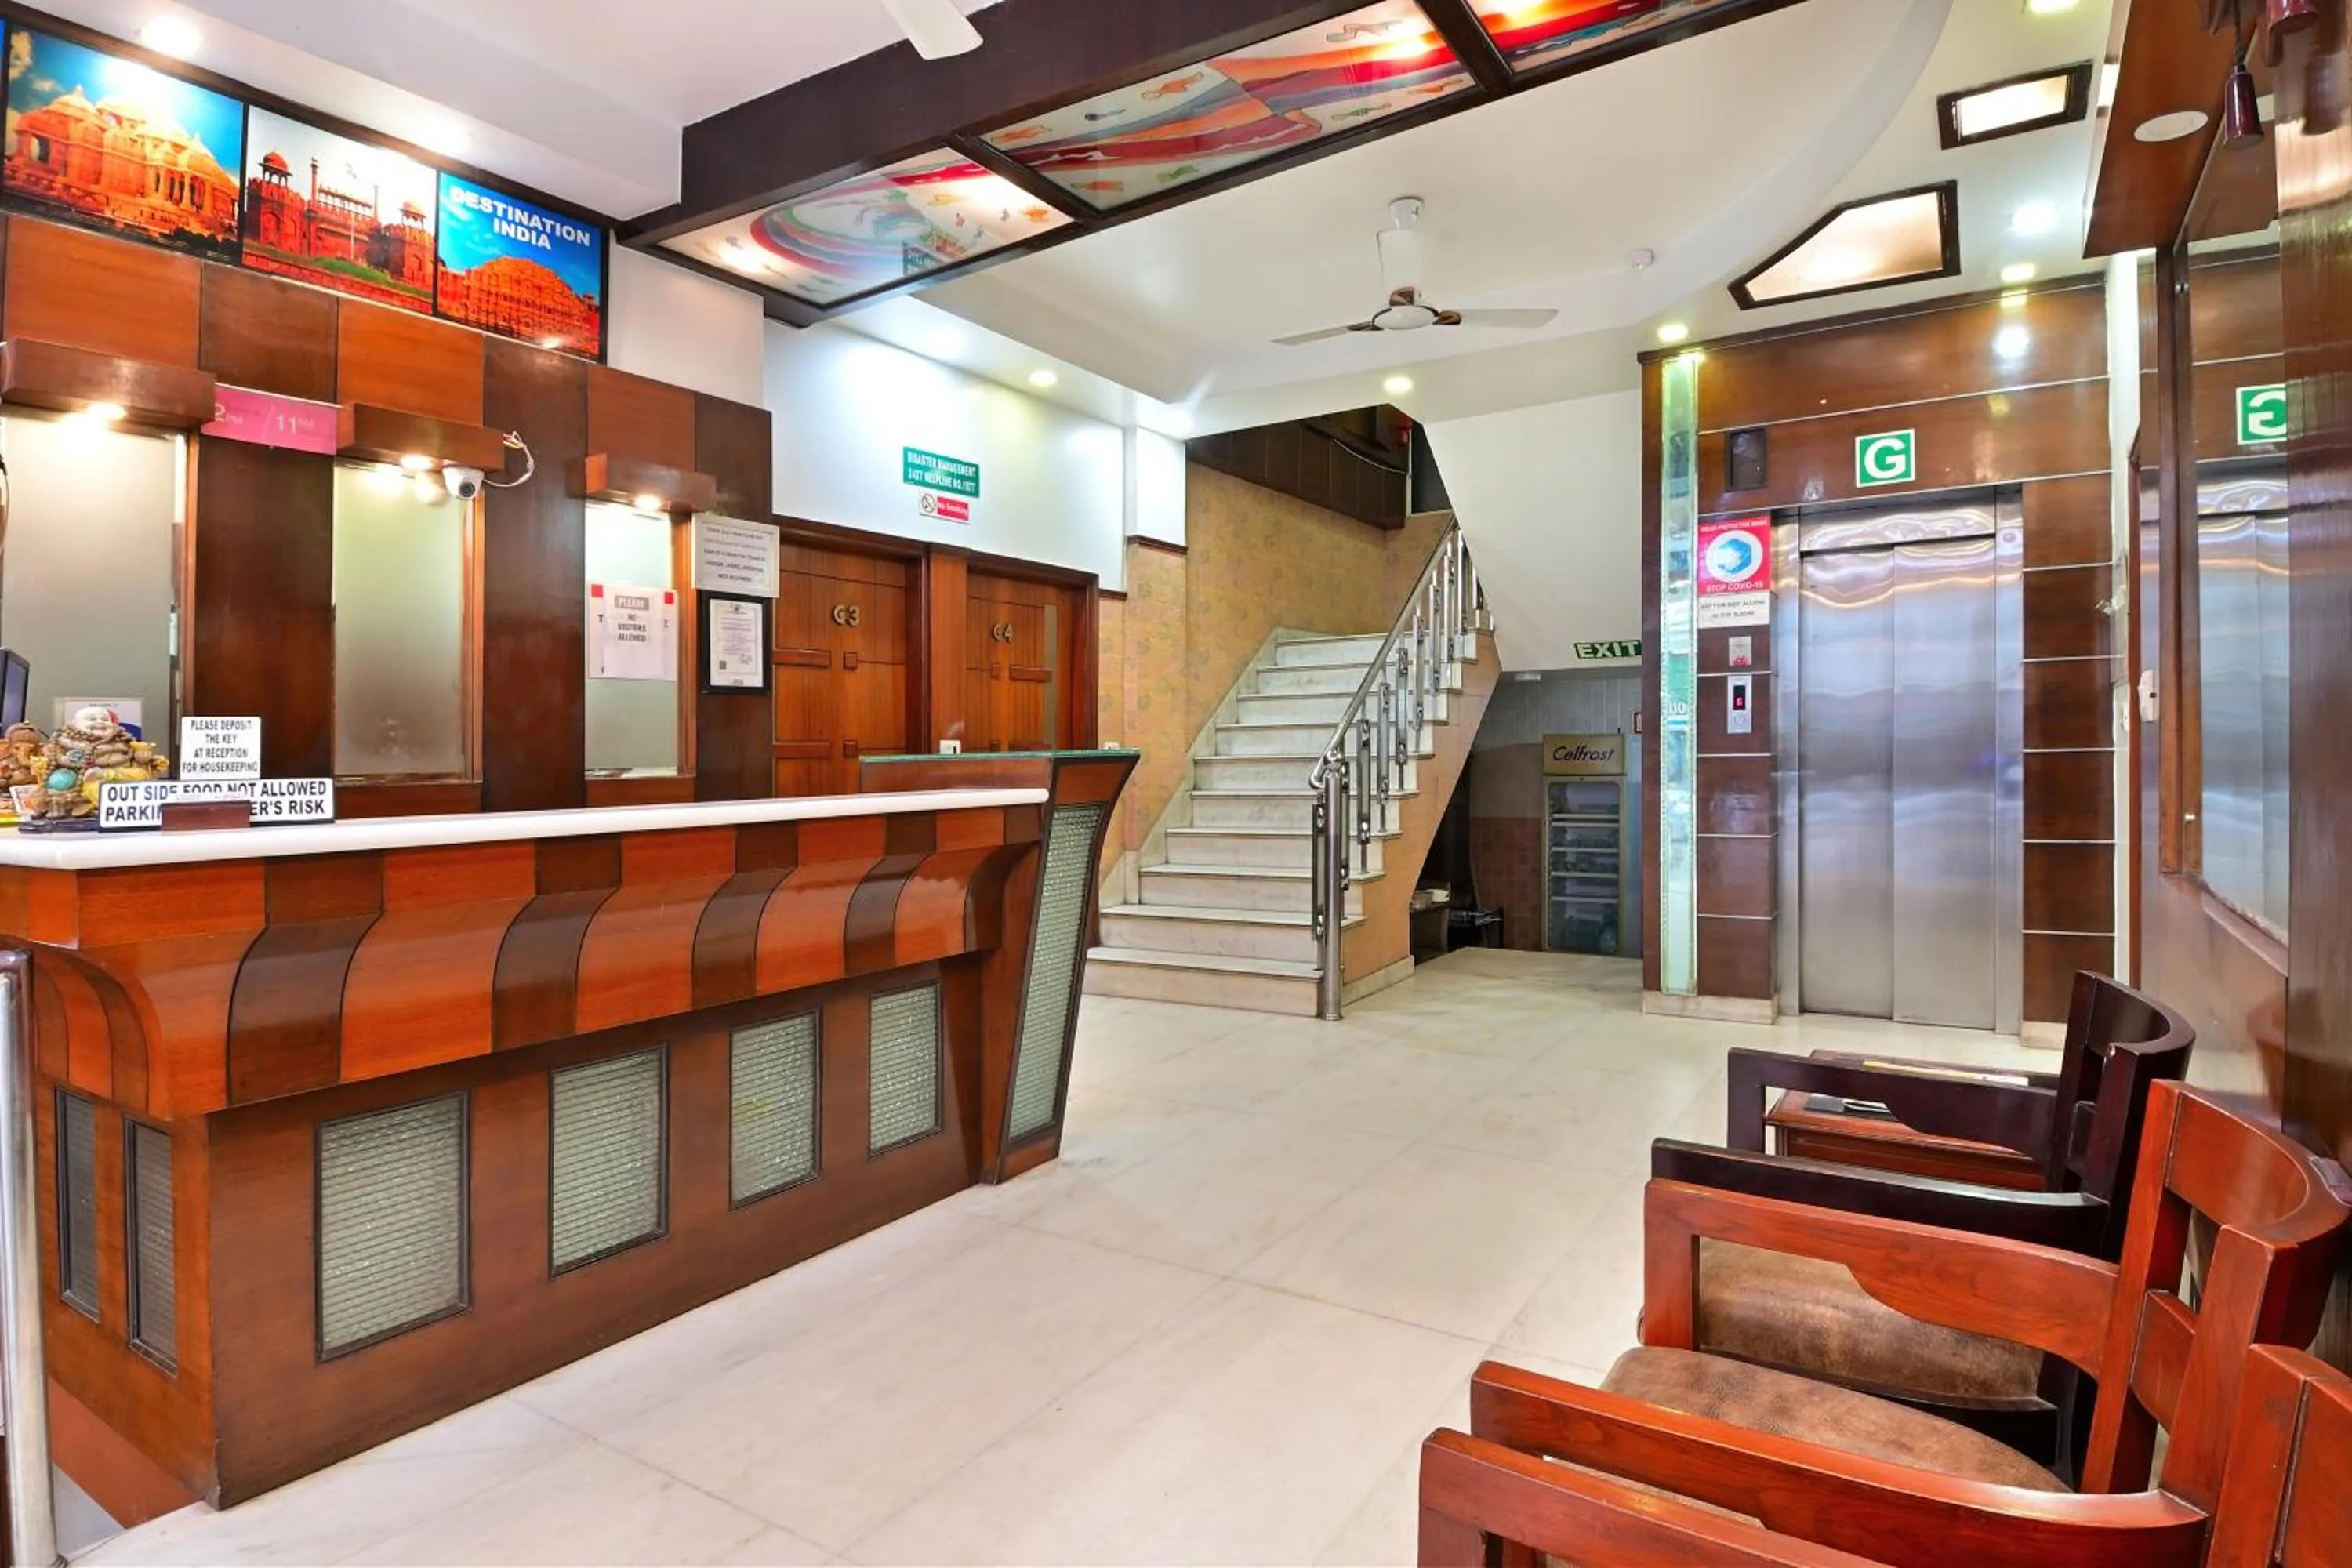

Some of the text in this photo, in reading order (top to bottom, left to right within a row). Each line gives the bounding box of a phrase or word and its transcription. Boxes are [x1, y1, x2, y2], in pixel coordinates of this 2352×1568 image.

[448, 185, 590, 247] DESTINATION
[493, 218, 551, 250] INDIA
[1864, 437, 1907, 479] G
[833, 604, 860, 626] G3
[992, 623, 1013, 643] G4
[1577, 641, 1639, 658] EXIT
[191, 720, 251, 730] PLEASE DEPOSIT
[205, 733, 237, 743] THE KEY
[194, 747, 249, 758] AT RECEPTION
[182, 761, 258, 773] FOR HOUSEKEEPING
[107, 786, 139, 801] OUT
[144, 785, 177, 800] SIDE
[260, 781, 327, 797] ALLOWED
[106, 800, 325, 822] PARKI ER'S RISK
